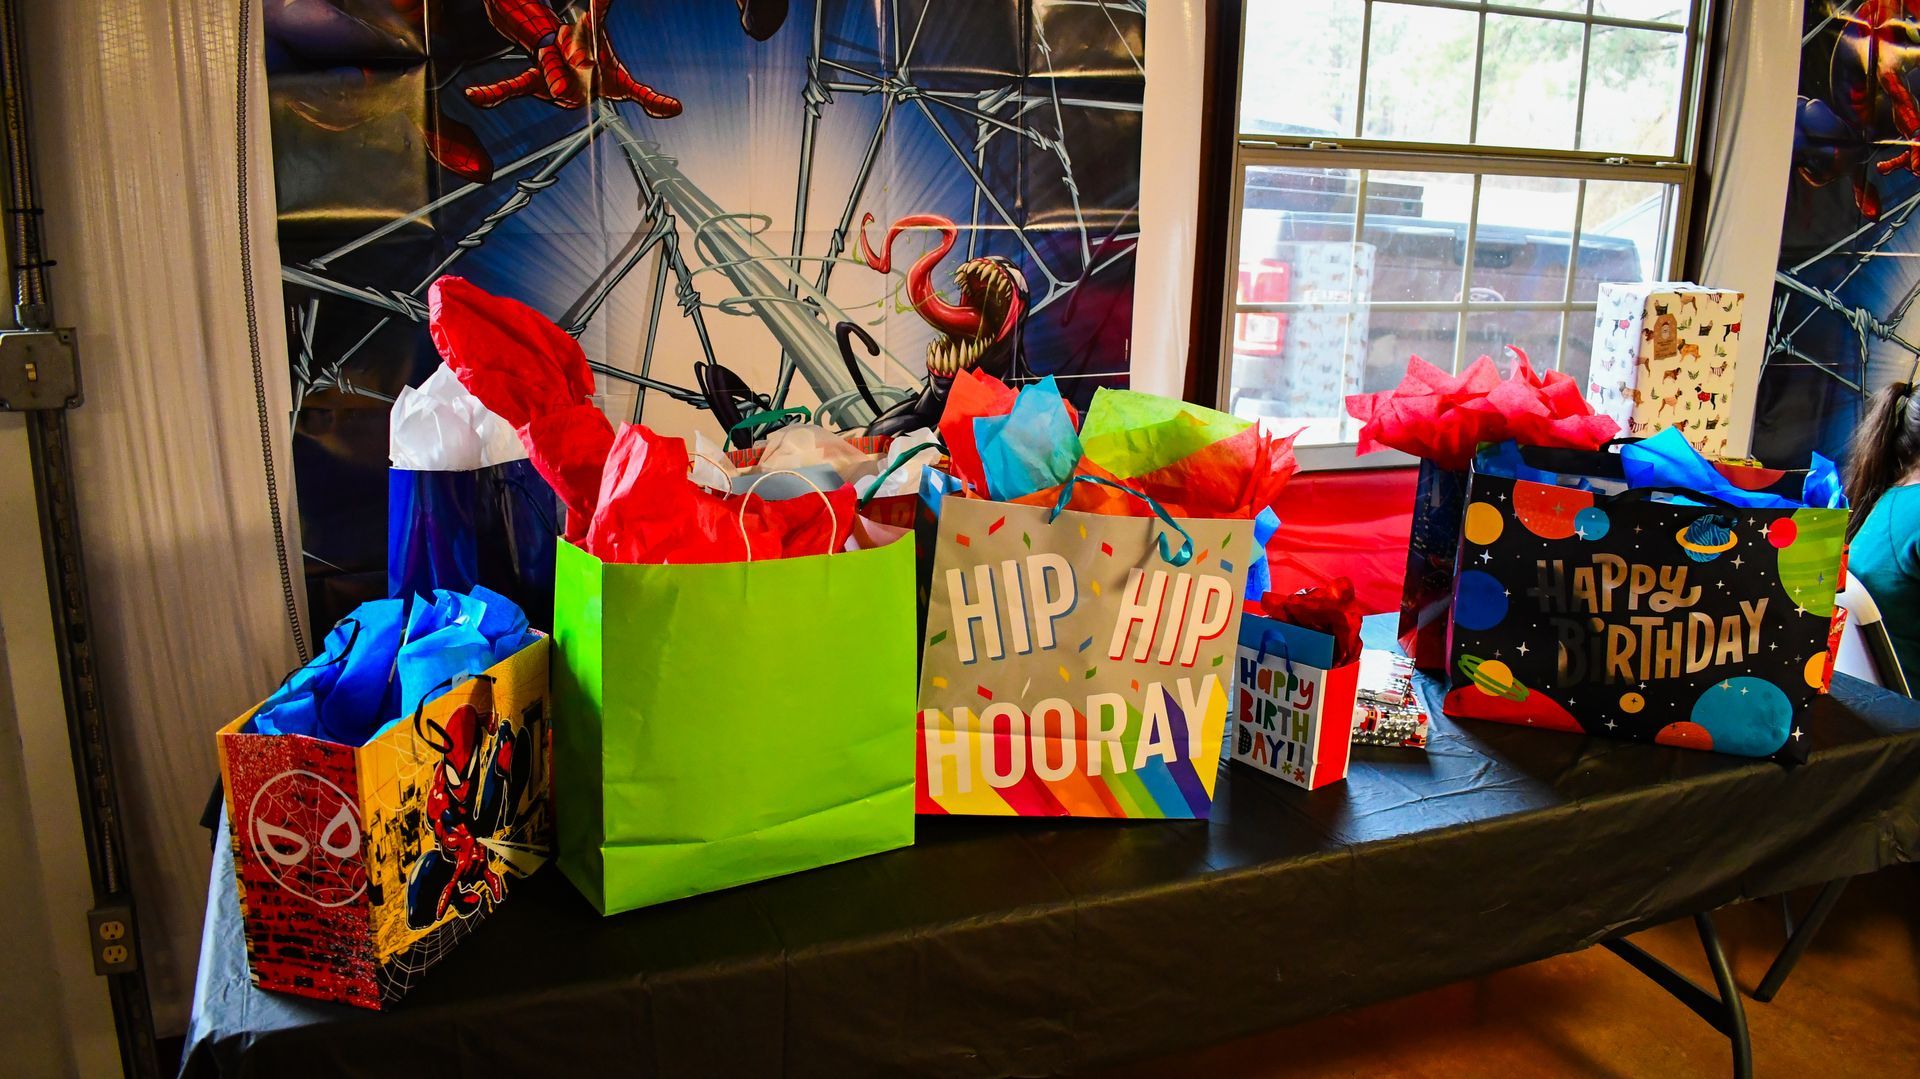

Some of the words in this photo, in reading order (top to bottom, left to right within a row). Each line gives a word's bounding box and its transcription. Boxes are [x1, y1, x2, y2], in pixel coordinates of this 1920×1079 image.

[946, 553, 1077, 664] HIP
[1108, 568, 1234, 667] HIP
[924, 673, 1217, 797] HOORAY
[1238, 723, 1305, 783] DAY!!
[1240, 687, 1309, 744] BIRTH
